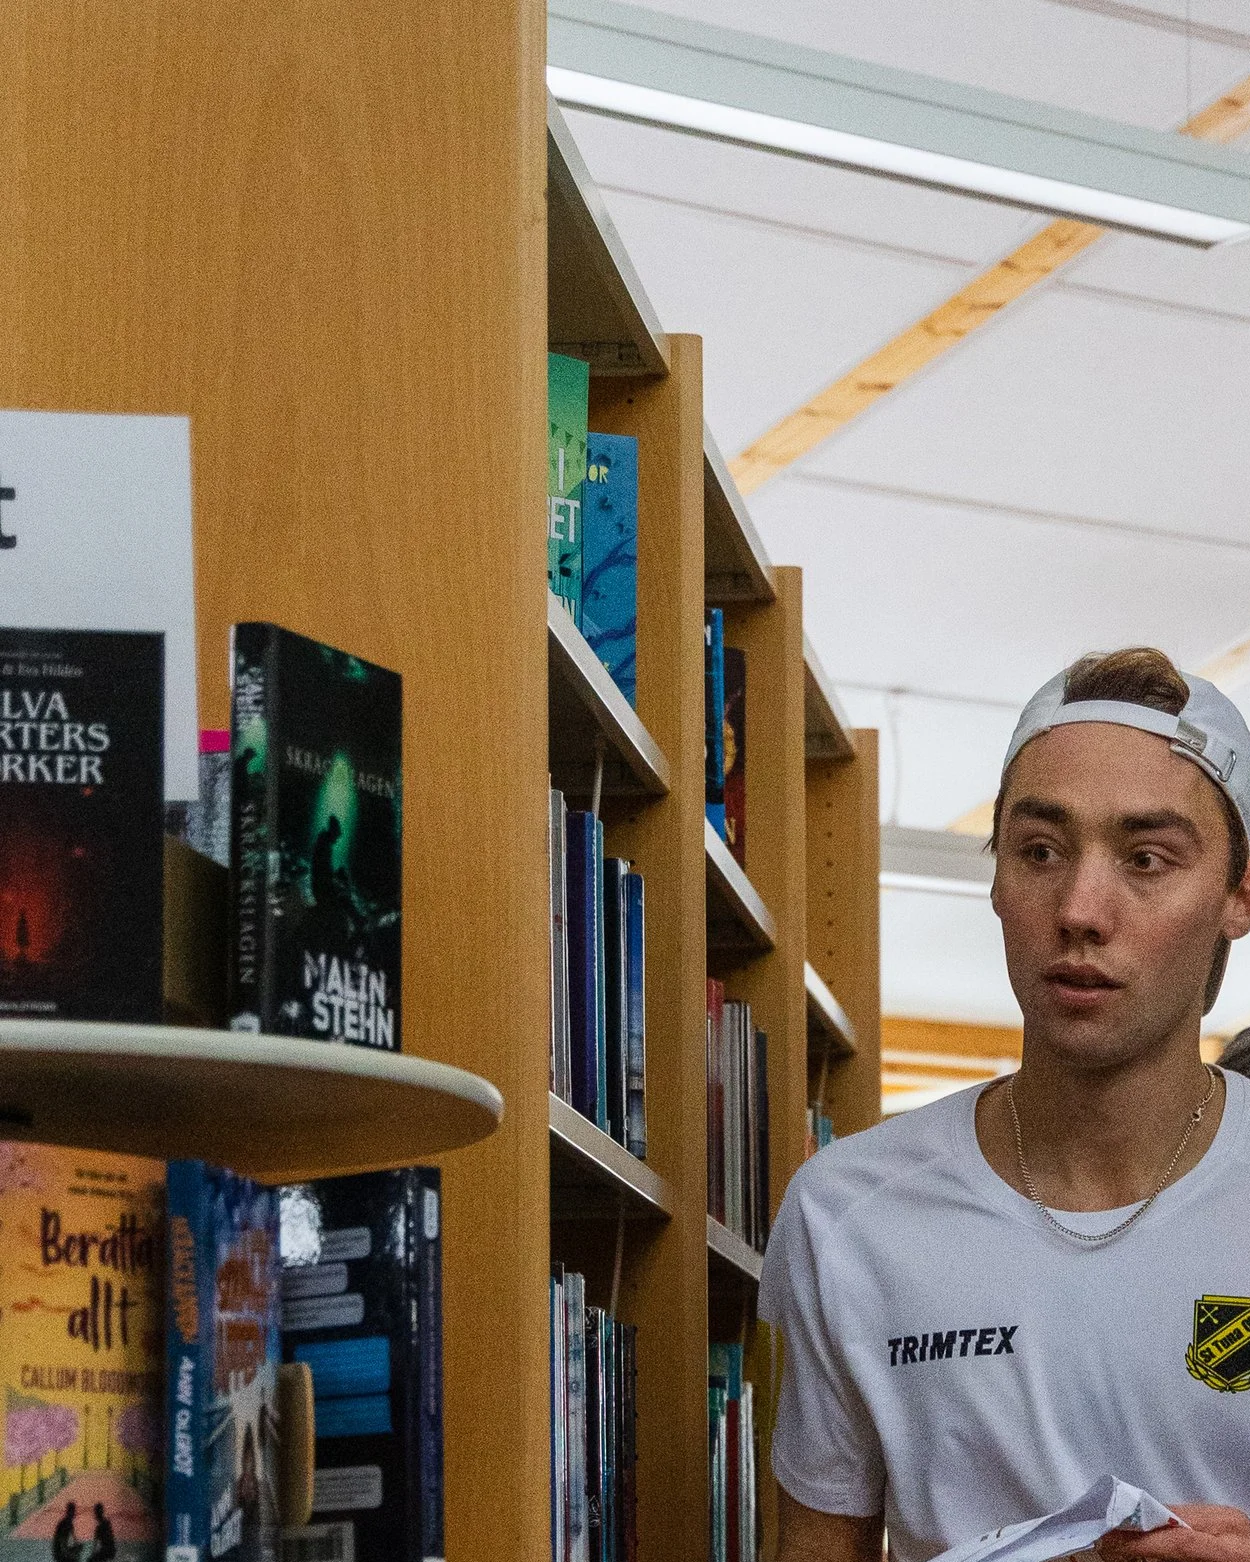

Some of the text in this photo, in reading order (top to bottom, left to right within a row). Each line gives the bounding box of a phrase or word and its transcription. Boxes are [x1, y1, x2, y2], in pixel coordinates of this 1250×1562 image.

[548, 496, 580, 543] ET
[304, 949, 386, 1007] MALIN
[312, 990, 395, 1050] STEHN
[67, 1274, 139, 1353] allt
[887, 1326, 1018, 1367] TRIMTEX
[1212, 1328, 1244, 1354] Tuna
[20, 1364, 78, 1391] CALLUM
